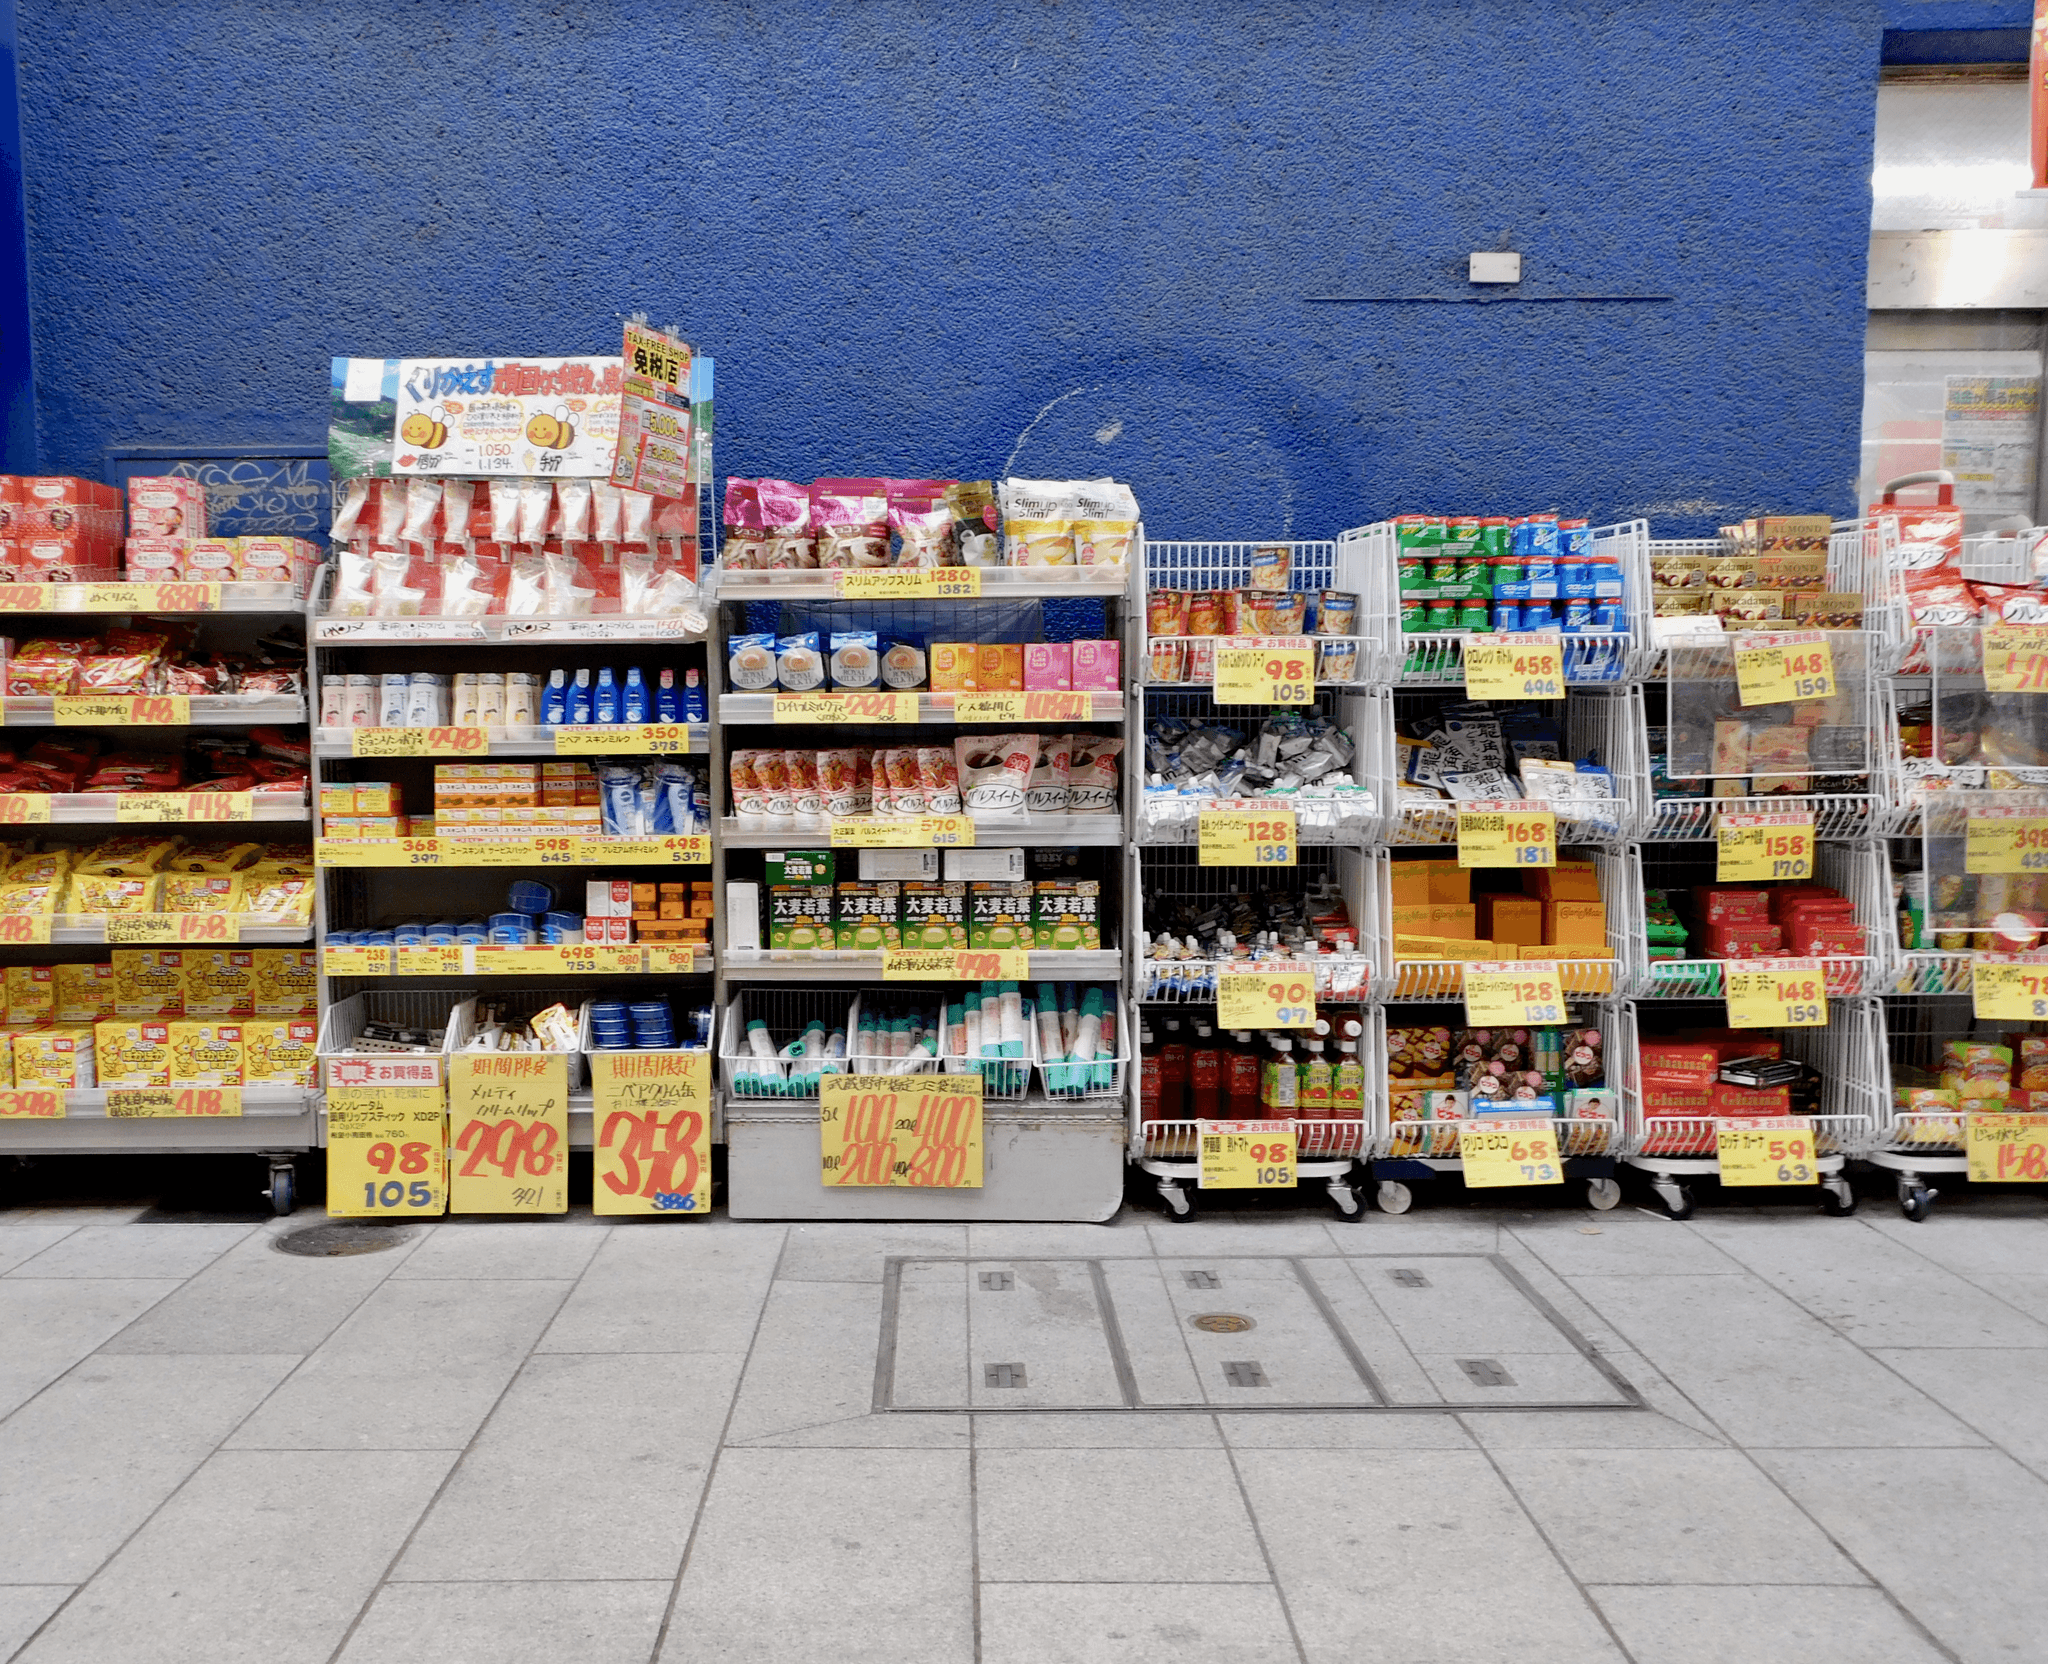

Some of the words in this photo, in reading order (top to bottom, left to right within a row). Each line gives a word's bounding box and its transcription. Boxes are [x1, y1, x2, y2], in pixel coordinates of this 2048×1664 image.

[626, 331, 667, 355] TAX-FREE
[668, 346, 690, 363] SHOP
[634, 347, 680, 386] 免税店
[1772, 525, 1822, 534] ALMOND
[930, 569, 971, 582] 1280
[1768, 563, 1818, 573] ALMOND
[846, 575, 922, 587] スリムアップスリム
[938, 584, 971, 595] 1382
[156, 584, 210, 610] 880
[1722, 596, 1776, 607] Macadamia
[1804, 599, 1855, 609] ALMOND
[1267, 638, 1308, 649] お買得品
[1265, 659, 1305, 681] 98
[1514, 655, 1555, 676] 458
[1783, 652, 1824, 677] 148
[1273, 683, 1307, 702] 105
[1523, 678, 1556, 696] 494
[1794, 677, 1827, 697] 159
[131, 697, 173, 724] 148
[1024, 692, 1085, 721] 1080
[429, 728, 483, 751] 298
[585, 734, 631, 744] スキンミルク
[642, 727, 679, 740] 350
[649, 741, 679, 752] 378
[968, 788, 1021, 802] パルスイート
[187, 793, 233, 821] 148
[921, 819, 957, 832] 570
[1247, 821, 1288, 842] 128
[1506, 822, 1547, 843] 168
[402, 839, 439, 852] 368
[534, 838, 571, 852] 598
[663, 837, 701, 850] 498
[932, 833, 957, 844] 615
[1765, 835, 1807, 857] 158
[410, 853, 439, 864] 397
[541, 852, 571, 863] 645
[672, 851, 702, 863] 537
[1256, 844, 1288, 863] 138
[1515, 846, 1548, 864] 181
[784, 865, 813, 875] 大麦若葉
[1773, 858, 1806, 877] 170
[773, 898, 831, 915] 大麦若葉
[840, 898, 897, 915] 大麦若葉
[906, 897, 963, 914] 大麦若葉
[974, 897, 1031, 914] 大麦若葉
[1039, 897, 1096, 914] 大麦若葉
[180, 914, 227, 941] 158
[367, 949, 386, 961] 238
[440, 948, 459, 961] 348
[560, 947, 595, 959] 698
[368, 963, 386, 973] 257
[442, 962, 460, 972] 375
[567, 961, 596, 971] 753
[1267, 983, 1306, 1004] 90
[1513, 981, 1555, 1002] 128
[1777, 980, 1817, 1002] 148
[1276, 1007, 1308, 1025] 97
[1524, 1004, 1558, 1022] 138
[1786, 1004, 1820, 1023] 159
[471, 1056, 548, 1079] 期間限定
[609, 1054, 697, 1079] 期間限定
[1643, 1053, 1708, 1071] Ghana
[379, 1065, 434, 1080] お買得品
[470, 1084, 517, 1101] メルティ
[1646, 1092, 1709, 1106] Ghana
[1720, 1092, 1782, 1106] Ghana
[175, 1089, 224, 1116] 418
[330, 1101, 384, 1111] メンソレータム
[329, 1111, 405, 1122] 薬用リップスティック
[413, 1111, 440, 1122] XD2P
[842, 1093, 898, 1144] 100
[912, 1094, 976, 1149] 400
[455, 1118, 560, 1179] 298
[1463, 1135, 1484, 1152] グリコ
[1487, 1135, 1509, 1152] ビスコ
[1511, 1140, 1549, 1162] 68
[1768, 1140, 1807, 1162] 59
[367, 1141, 433, 1175] 98
[1250, 1143, 1288, 1164] 98
[1997, 1142, 2048, 1180] 158
[836, 1142, 897, 1185] 200
[908, 1145, 967, 1188] 800
[1520, 1163, 1555, 1181] 73
[1257, 1166, 1290, 1185] 105
[1777, 1164, 1811, 1183] 63
[365, 1180, 433, 1208] 105
